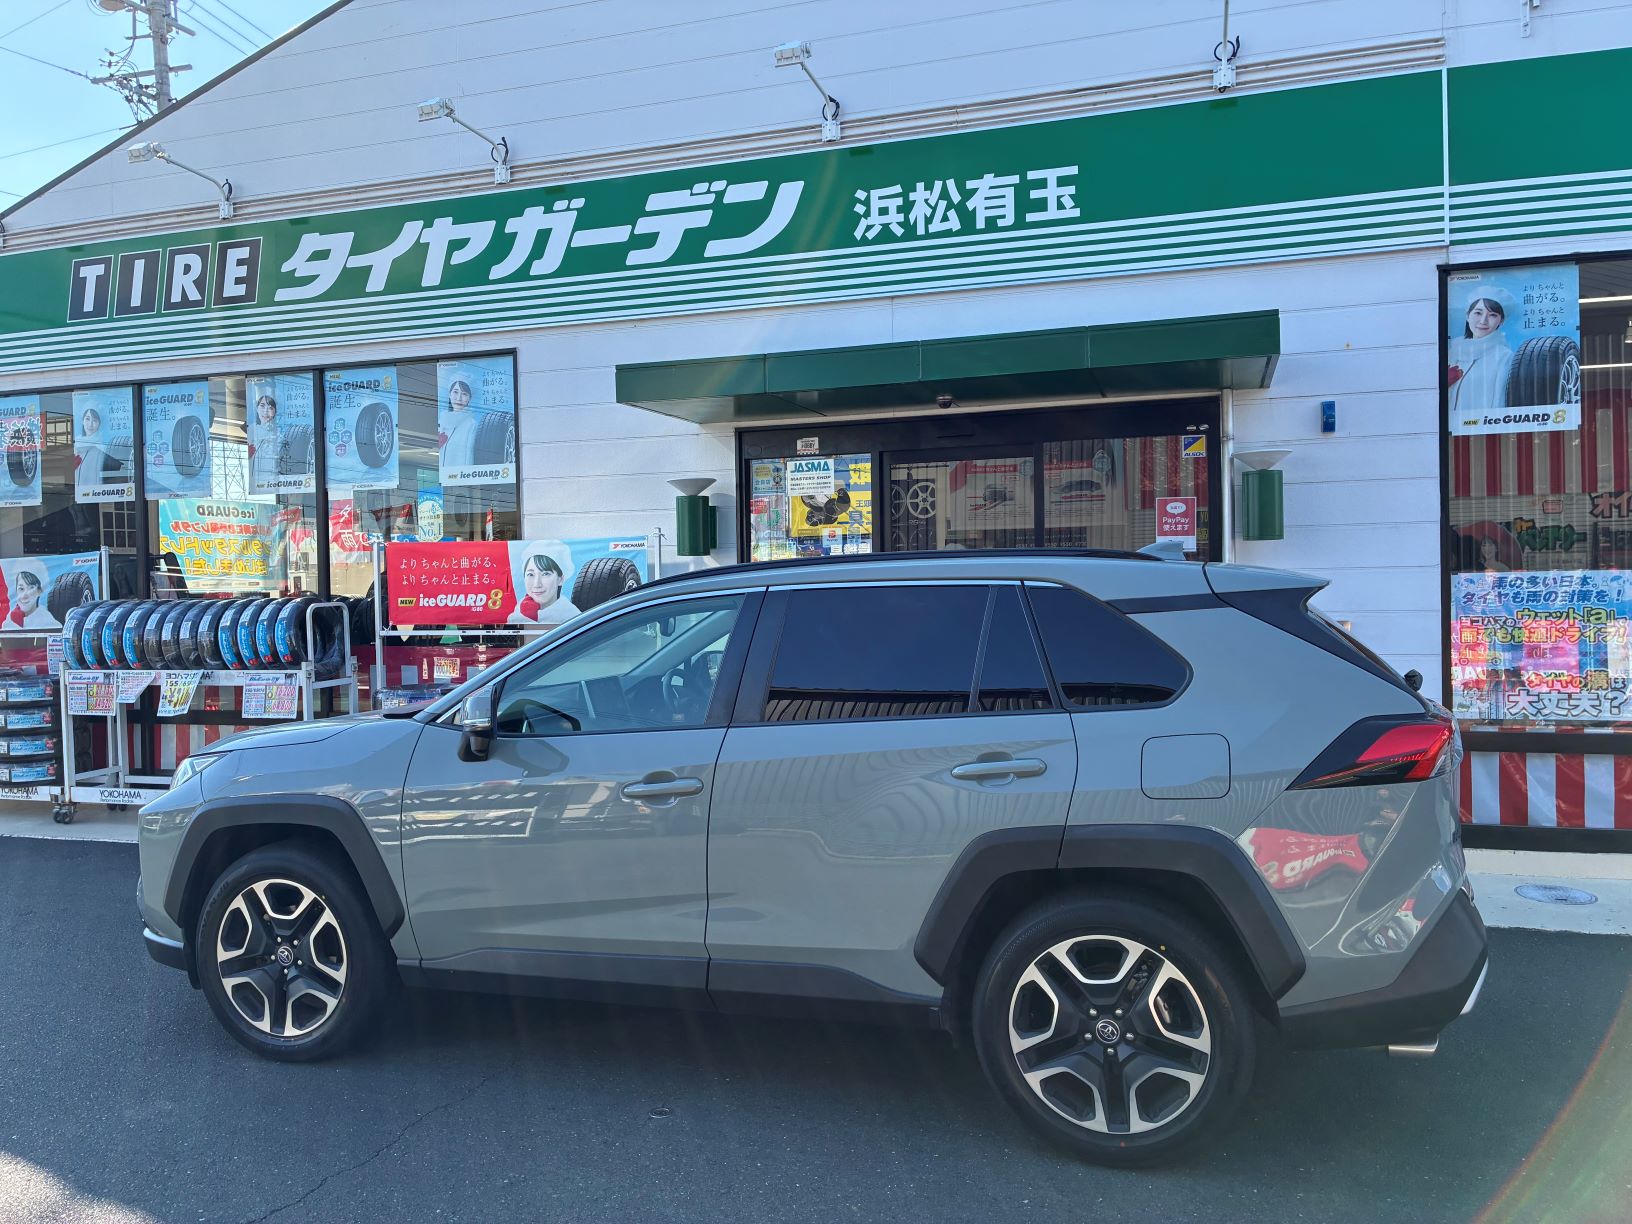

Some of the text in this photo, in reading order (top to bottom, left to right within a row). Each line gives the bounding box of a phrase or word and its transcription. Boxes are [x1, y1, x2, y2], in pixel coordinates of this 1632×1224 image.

[79, 165, 1081, 312] TIRE タイヤガーデン 浜松有玉
[1522, 282, 1565, 292] よりちゃんと
[1522, 292, 1566, 305] 曲がる。
[1522, 306, 1565, 316] よりちゃんと
[1522, 317, 1566, 330] 止まる。
[329, 394, 362, 410] 誕生。
[146, 406, 176, 422] 誕生。
[1483, 412, 1551, 425] iceGUARD
[790, 460, 831, 473] JASMA
[460, 469, 501, 480] iceGUARD
[92, 488, 126, 497] iceGUARD
[1162, 516, 1190, 524] PayPay
[1162, 524, 1190, 532] 使えます
[400, 556, 497, 569] よりちゃんと曲がる、
[402, 573, 496, 585] よりちゃんと止まる。
[1491, 574, 1599, 590] 雨の多い日本。
[419, 593, 487, 607] iceGUARD
[488, 588, 503, 610] 8
[1526, 669, 1627, 692] タイヤの溝は
[1506, 688, 1629, 718] 大丈夫?
[99, 789, 142, 800] YOKOHAMA
